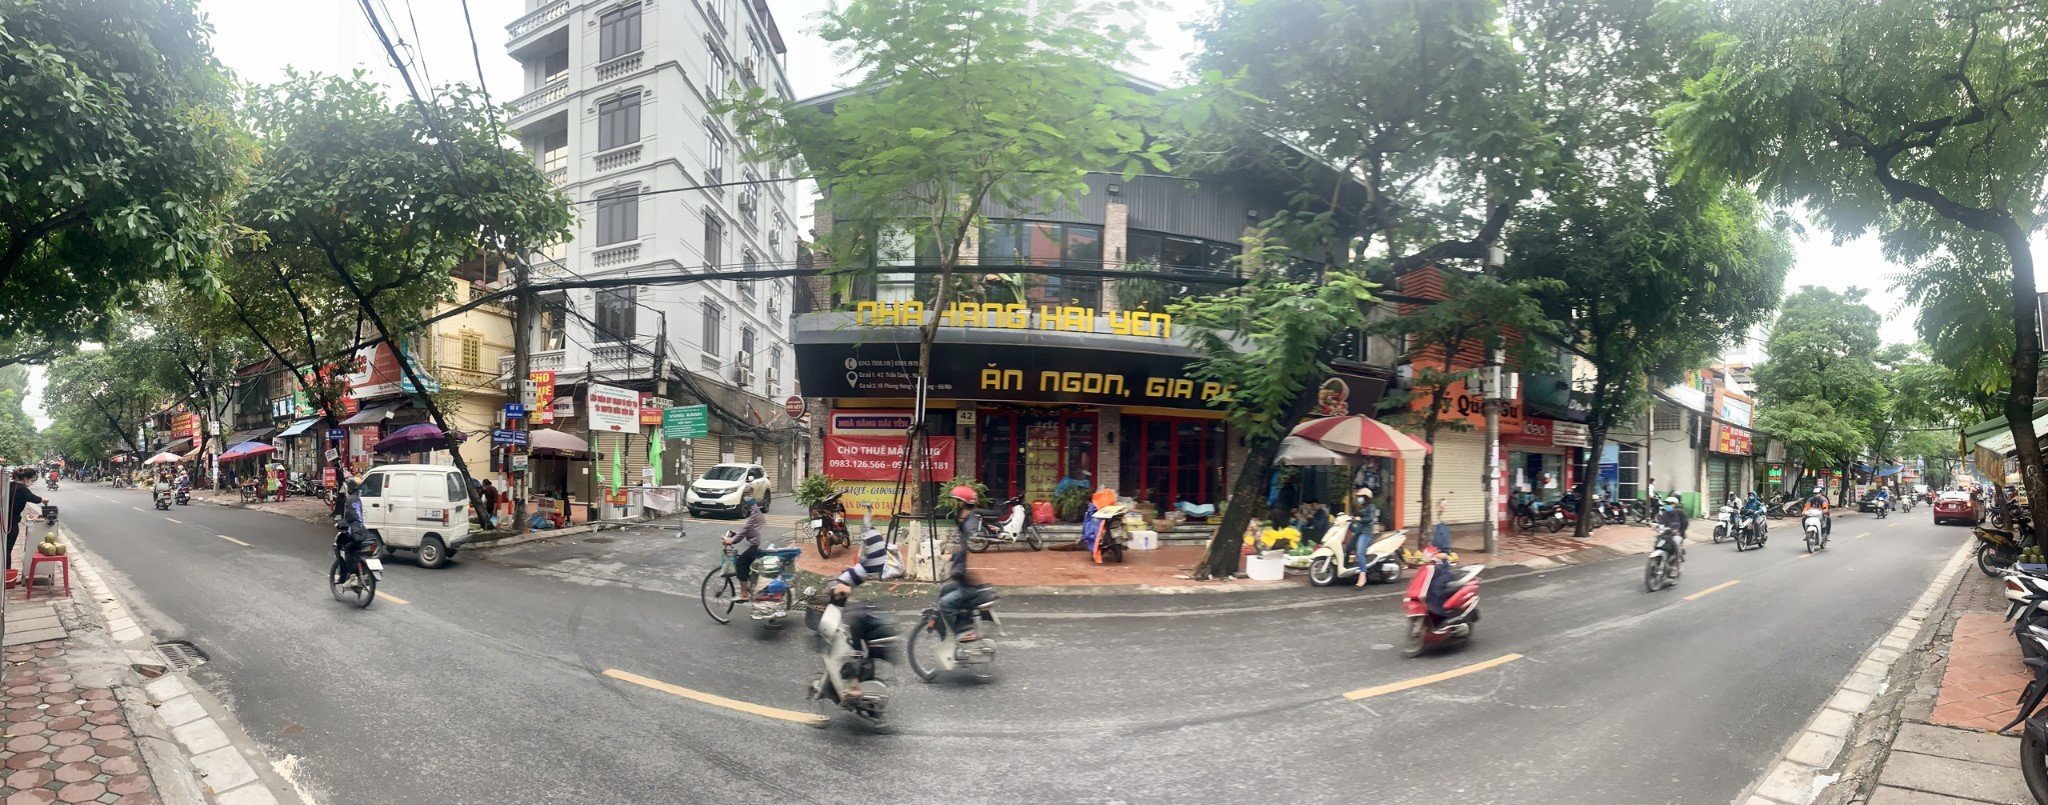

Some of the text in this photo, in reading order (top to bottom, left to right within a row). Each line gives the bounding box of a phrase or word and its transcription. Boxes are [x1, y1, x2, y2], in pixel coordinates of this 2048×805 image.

[1040, 298, 1094, 333] HẢI
[1109, 301, 1171, 338] YẾN
[981, 363, 1023, 390] ĂN
[1040, 371, 1130, 397] NGON,
[960, 412, 973, 420] 42
[838, 418, 854, 427] NHÀ
[855, 418, 877, 427] HÀNG
[877, 418, 891, 427] HẢI
[837, 446, 858, 454] CHO
[860, 445, 886, 455] THUÊ
[829, 459, 886, 469] 0983.126.566
